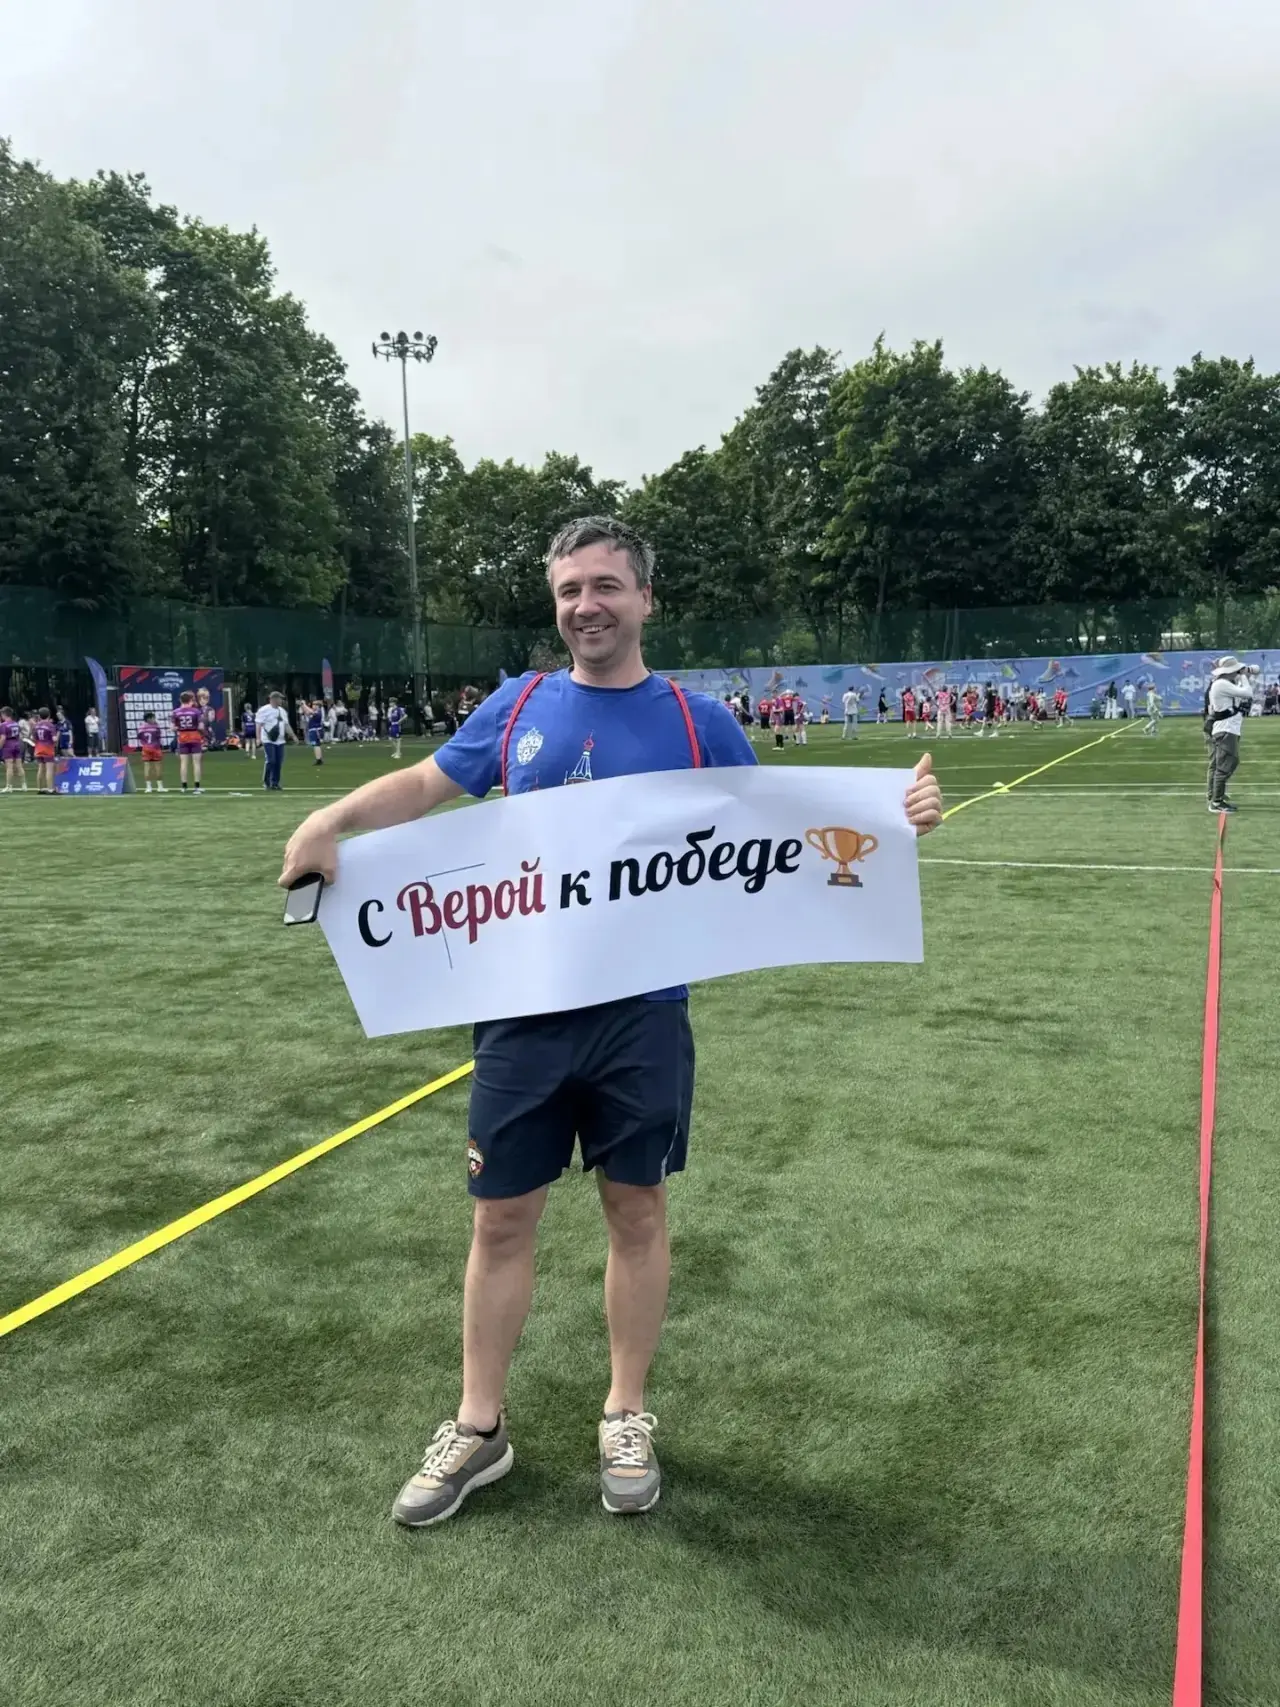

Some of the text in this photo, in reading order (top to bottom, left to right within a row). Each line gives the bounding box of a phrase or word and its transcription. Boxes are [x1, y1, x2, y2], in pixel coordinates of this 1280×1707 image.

[179, 715, 193, 728] 22
[144, 732, 152, 743] 7
[396, 856, 547, 945] Верой
[559, 870, 592, 910] к
[608, 825, 802, 900] победе
